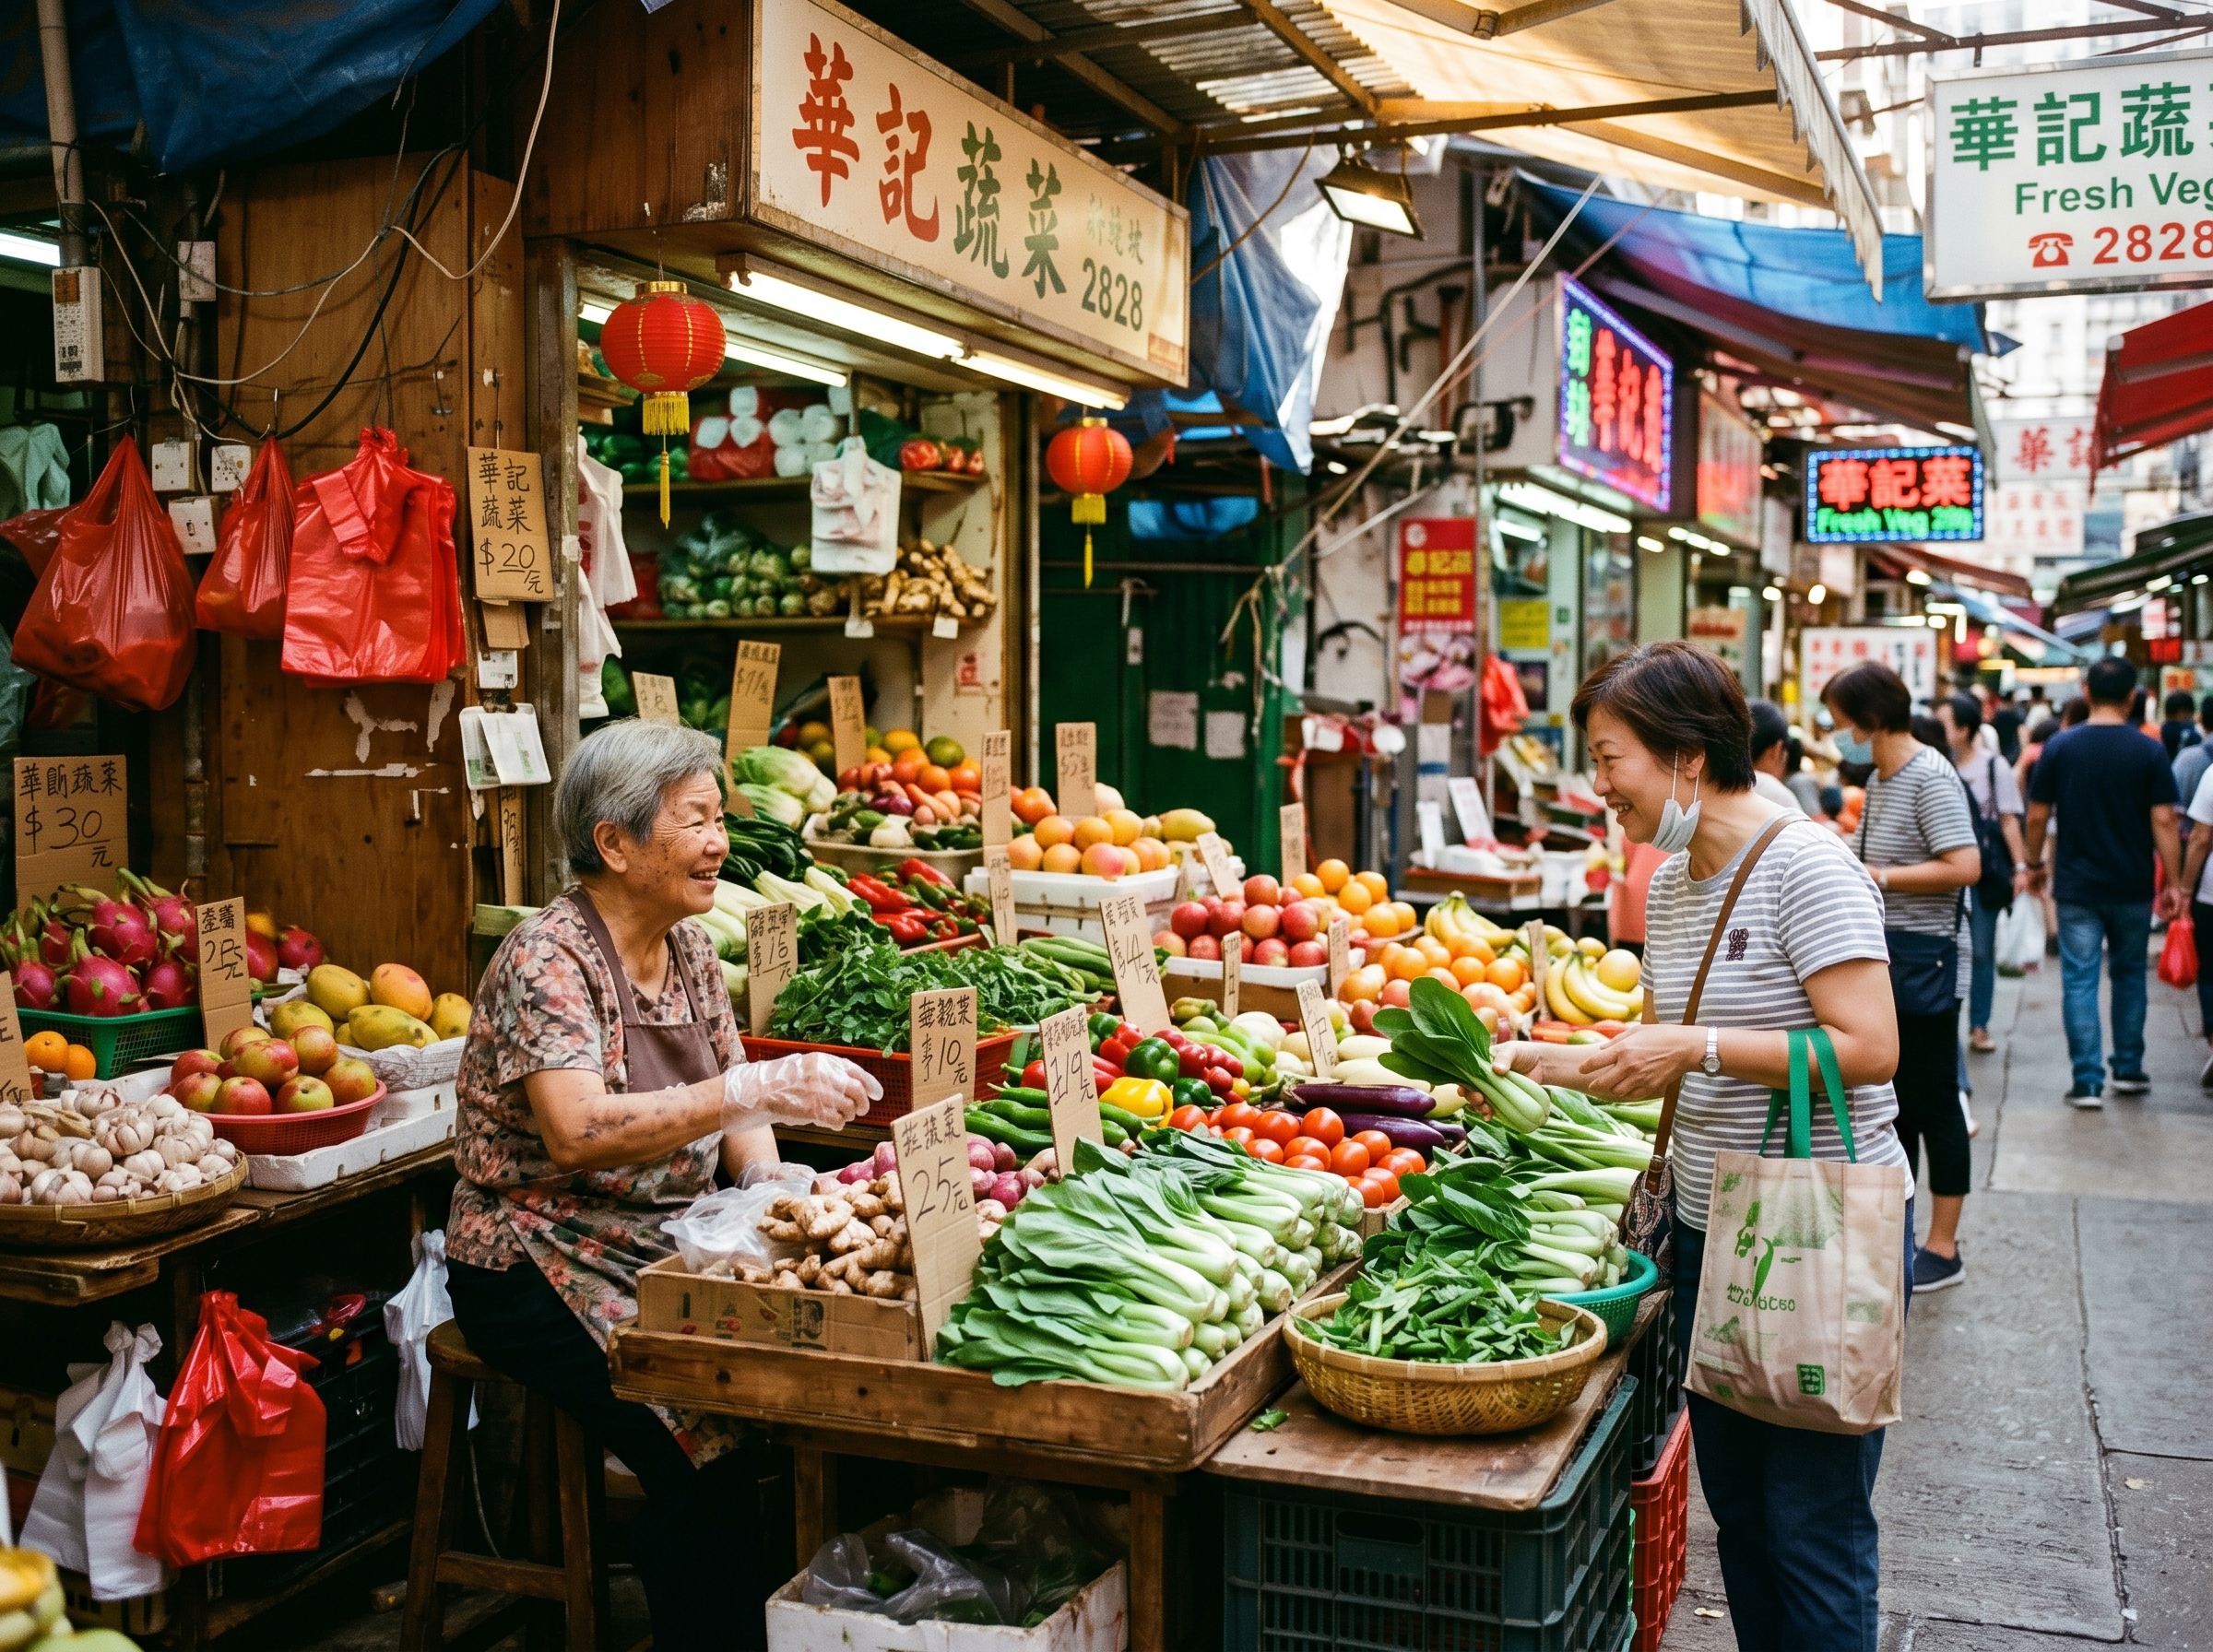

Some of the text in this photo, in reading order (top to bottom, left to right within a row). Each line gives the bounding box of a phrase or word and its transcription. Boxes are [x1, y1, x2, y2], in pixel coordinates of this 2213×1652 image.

[1949, 81, 2213, 171] 華記蔬
[792, 32, 1067, 301] 華記蔬菜
[2016, 176, 2133, 215] Fresh
[2092, 219, 2213, 266] 2828
[1082, 257, 1142, 332] 2828
[479, 452, 529, 493] 華記
[480, 494, 532, 535] 蔬菜
[91, 845, 113, 868] 元
[938, 1037, 961, 1076] 10
[953, 1062, 968, 1086] 元
[912, 1156, 954, 1222] 25
[952, 1181, 968, 1215] 元
